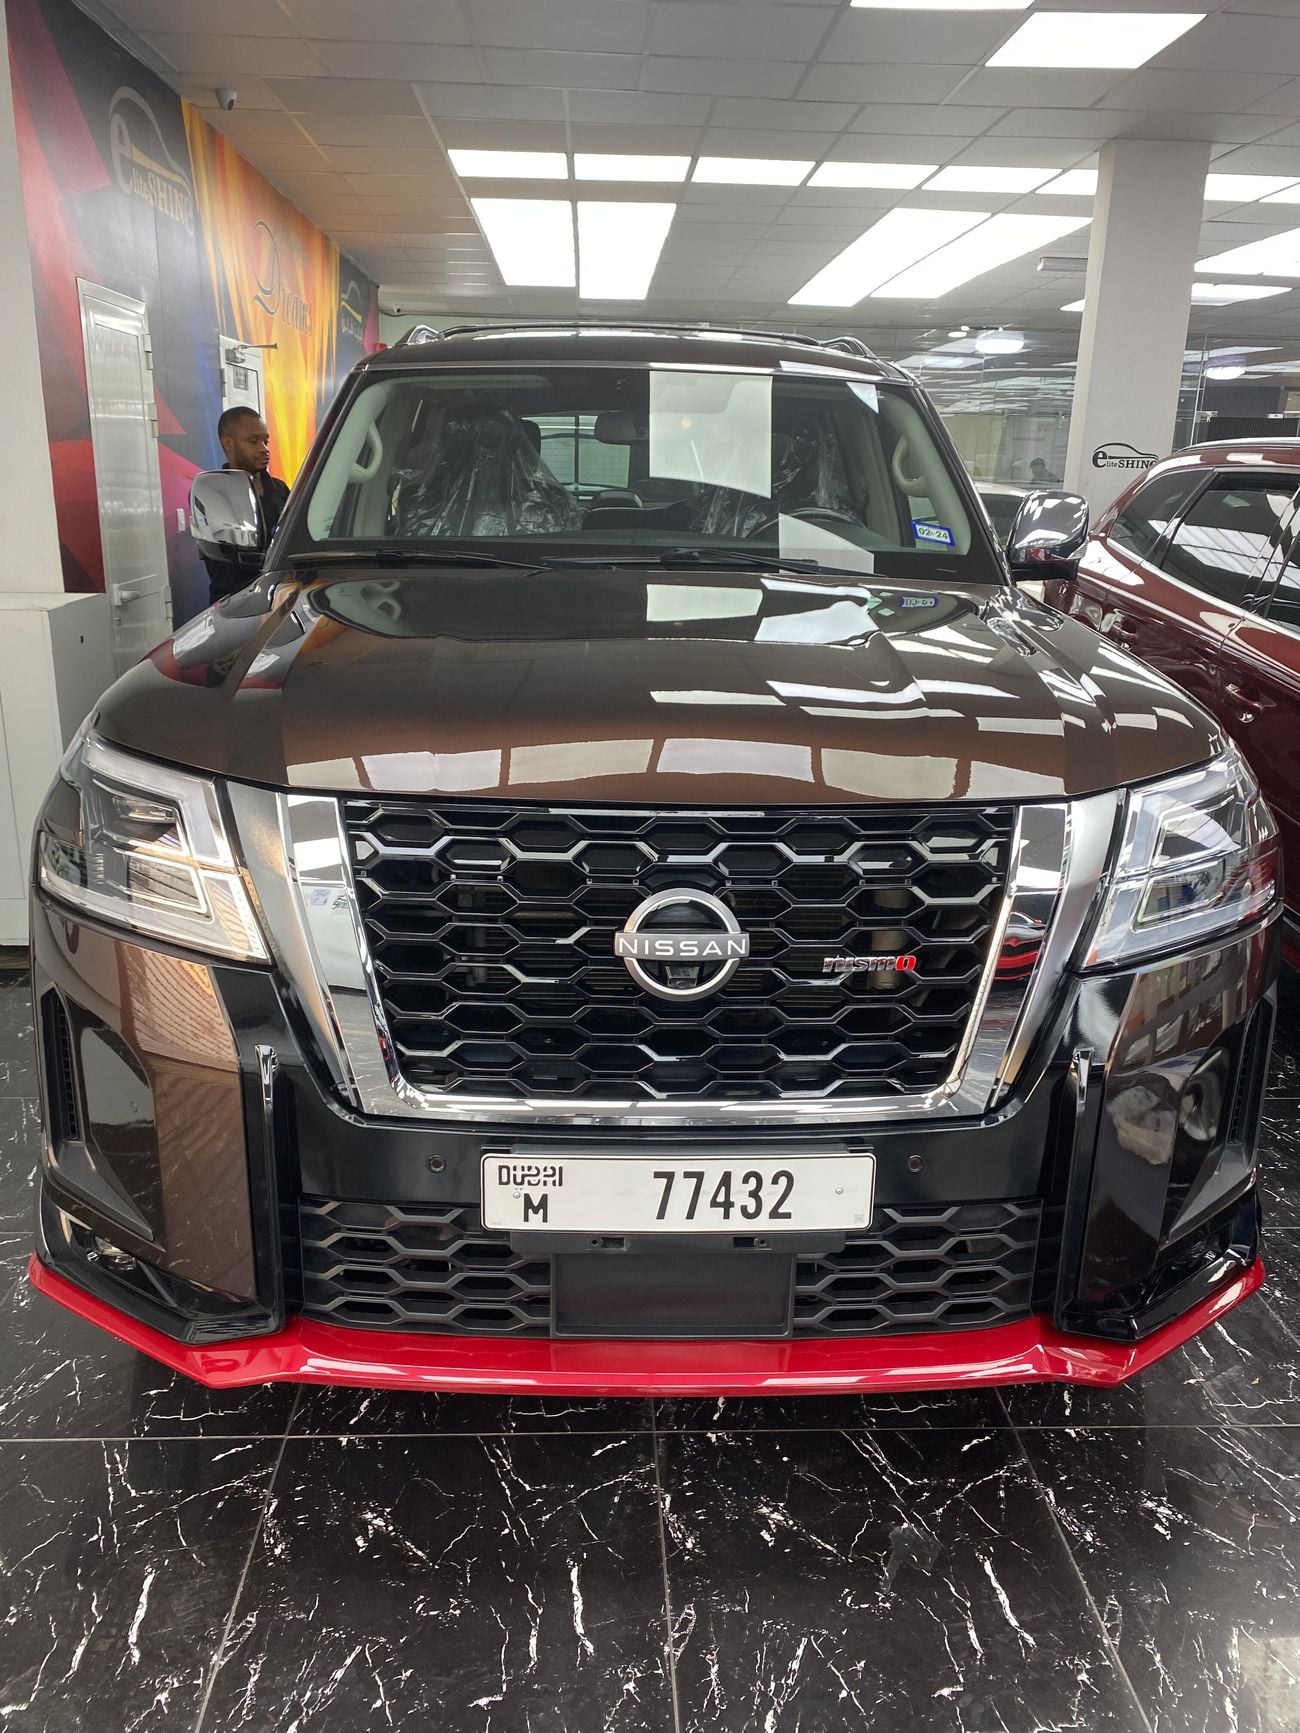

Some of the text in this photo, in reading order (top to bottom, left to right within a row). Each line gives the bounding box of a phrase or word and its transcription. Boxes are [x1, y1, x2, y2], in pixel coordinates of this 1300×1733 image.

[620, 937, 746, 956] NISSAN
[498, 1165, 563, 1187] DUBAI
[523, 1170, 795, 1223] M 77432
